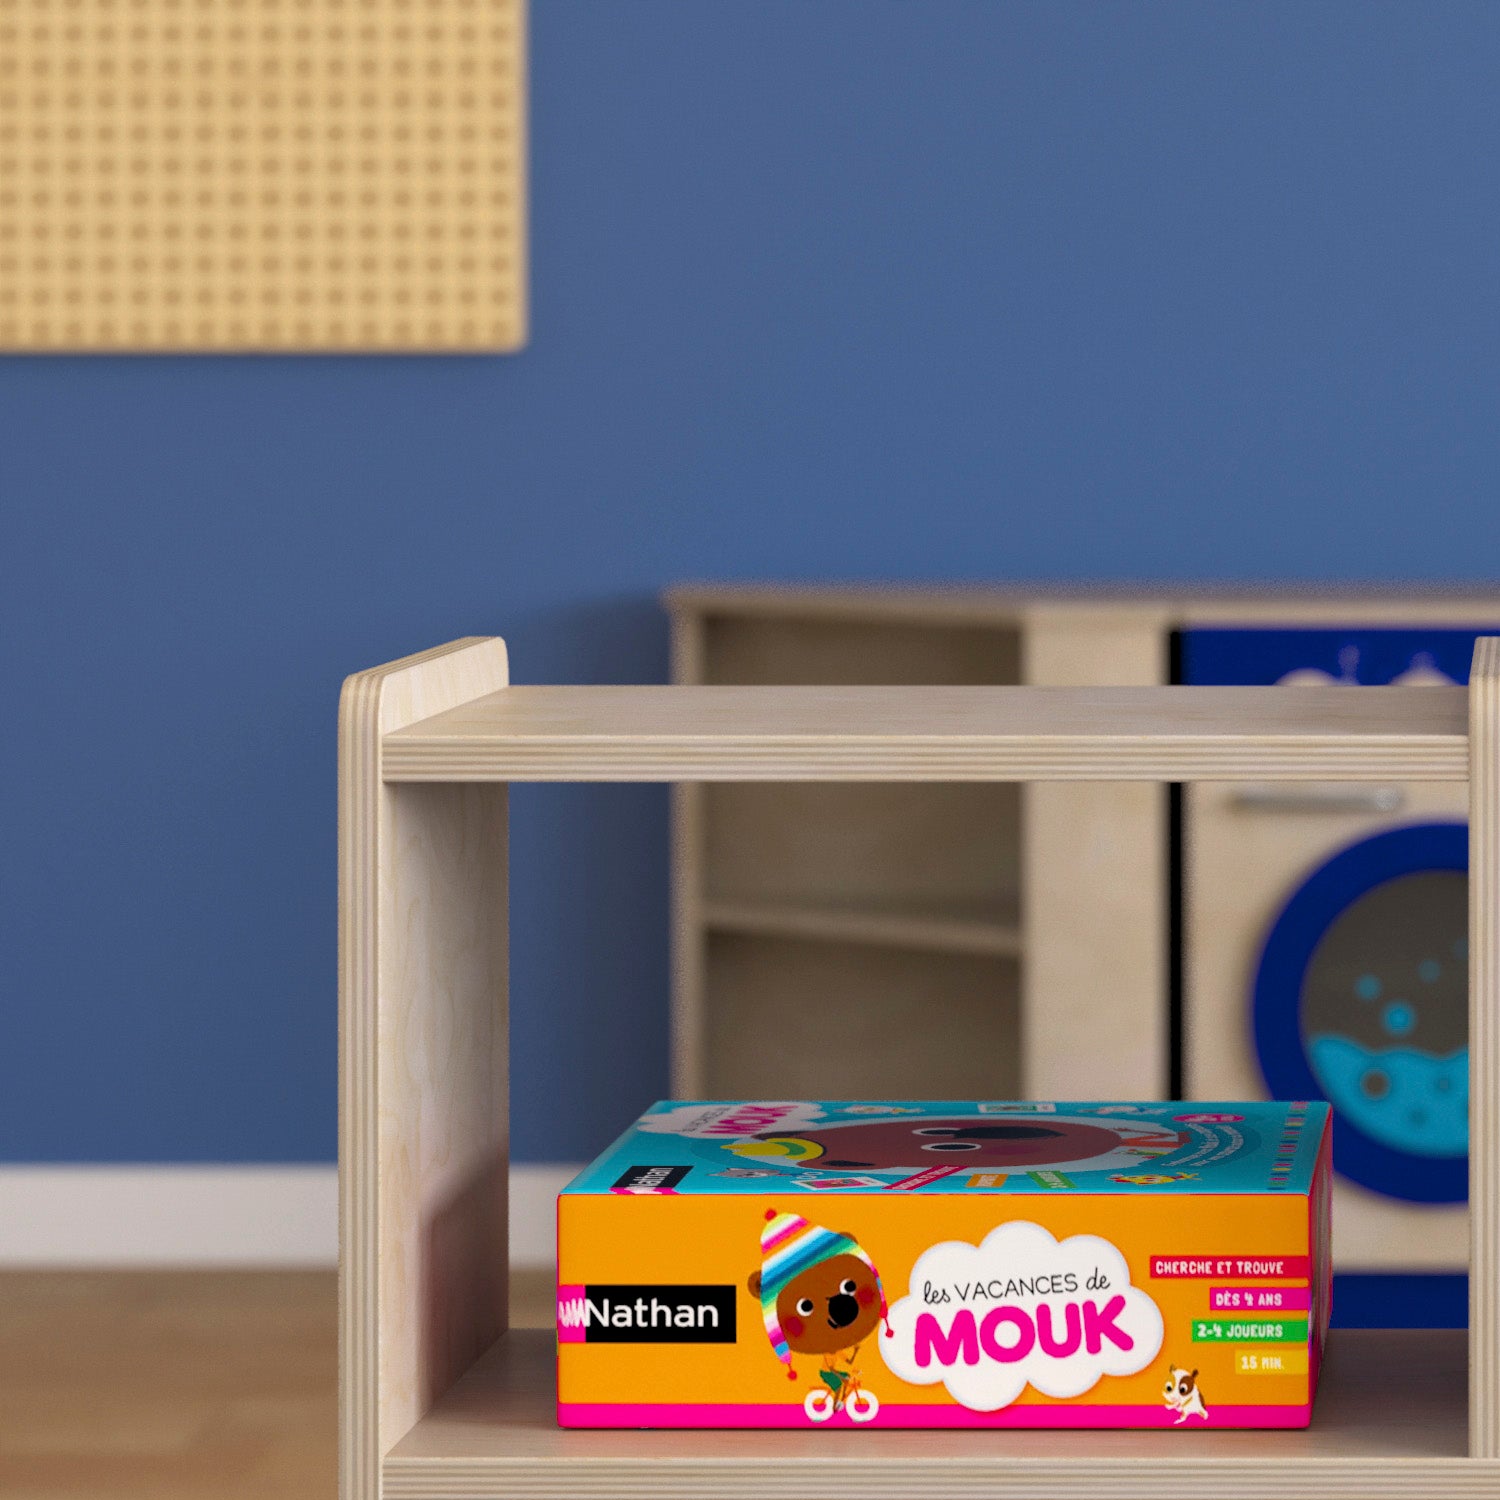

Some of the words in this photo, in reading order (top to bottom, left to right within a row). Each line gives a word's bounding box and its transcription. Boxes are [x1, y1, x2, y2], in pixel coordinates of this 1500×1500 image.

[1155, 1260, 1213, 1275] CHERCHE
[1217, 1260, 1233, 1275] ET
[1236, 1260, 1284, 1275] TROUVE
[923, 1280, 951, 1305] les
[954, 1272, 1079, 1301] VACANCES
[1086, 1266, 1111, 1291] de
[1215, 1290, 1240, 1307] DÈS
[1243, 1292, 1254, 1307] 4
[1258, 1292, 1283, 1307] ANS
[585, 1297, 719, 1328] Nathan
[914, 1294, 1135, 1368] MOUK
[1197, 1323, 1222, 1338] 2-4
[1226, 1323, 1284, 1338] JOUEURS
[1241, 1355, 1258, 1370] 15
